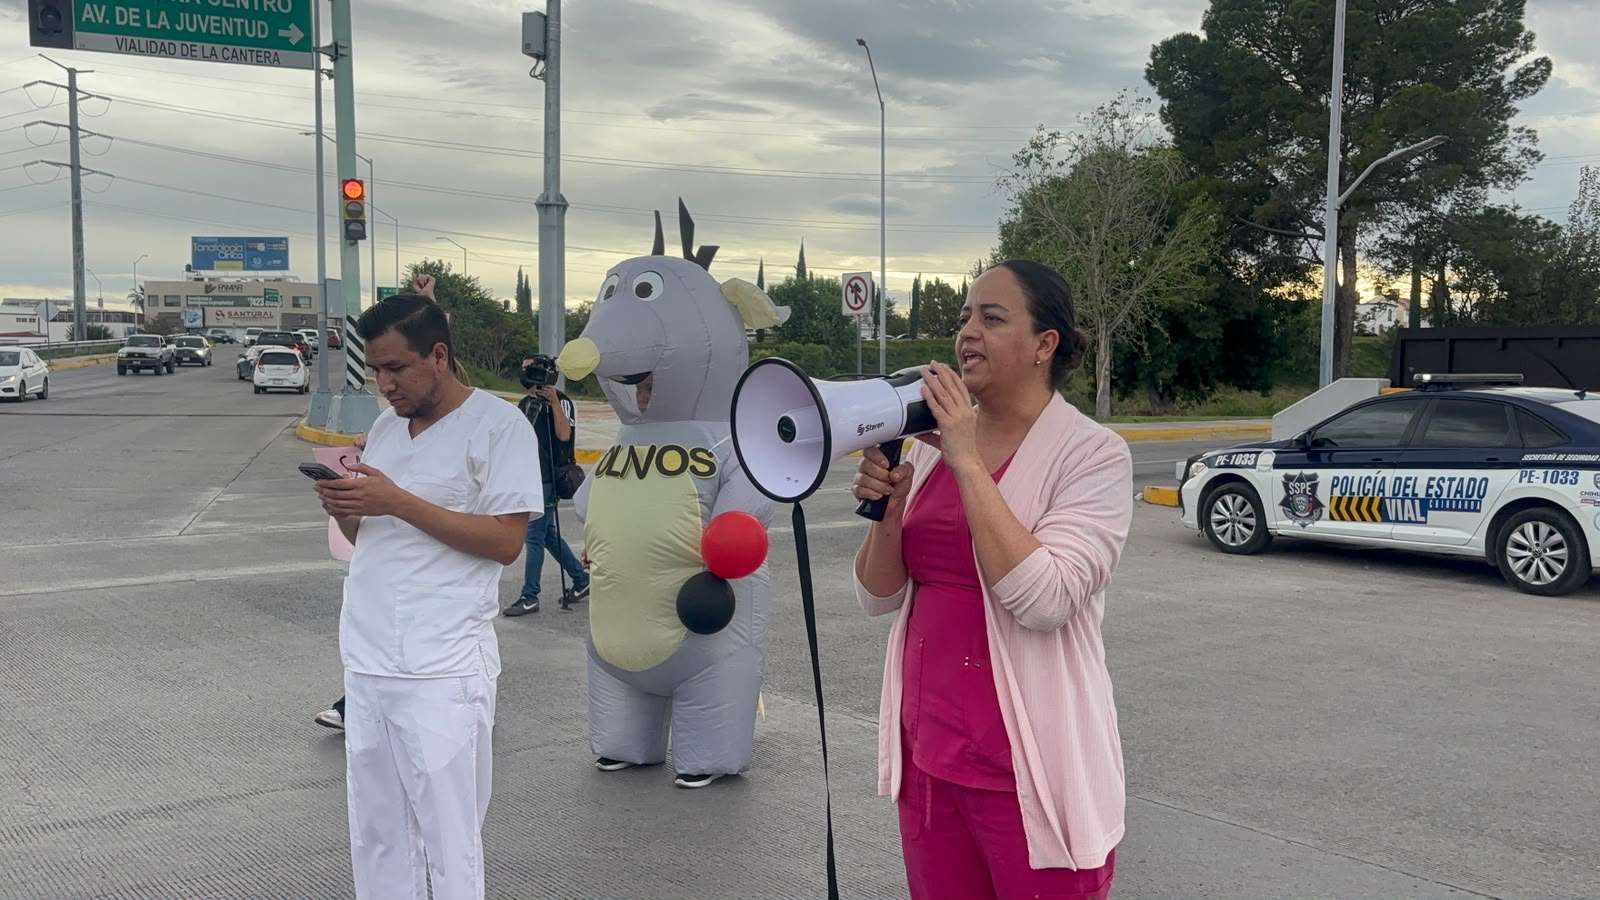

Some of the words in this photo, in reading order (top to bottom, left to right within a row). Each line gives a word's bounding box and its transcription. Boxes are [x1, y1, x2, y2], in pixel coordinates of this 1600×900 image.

[82, 3, 110, 24] AV.
[115, 6, 141, 27] DE
[146, 9, 171, 30] LA
[175, 12, 269, 38] JUVENTUD
[115, 36, 177, 56] VIALIDAD
[180, 43, 198, 58] DE
[201, 45, 218, 60] LA
[221, 47, 281, 64] CANTERA
[1215, 453, 1257, 467] PE-1033
[1289, 482, 1313, 496] SSPE
[1330, 470, 1386, 497] POLICÍA
[1392, 476, 1419, 498] DEL
[1425, 476, 1489, 500] ESTADO
[1519, 470, 1580, 486] PE-1033
[1385, 498, 1426, 522] VIAL
